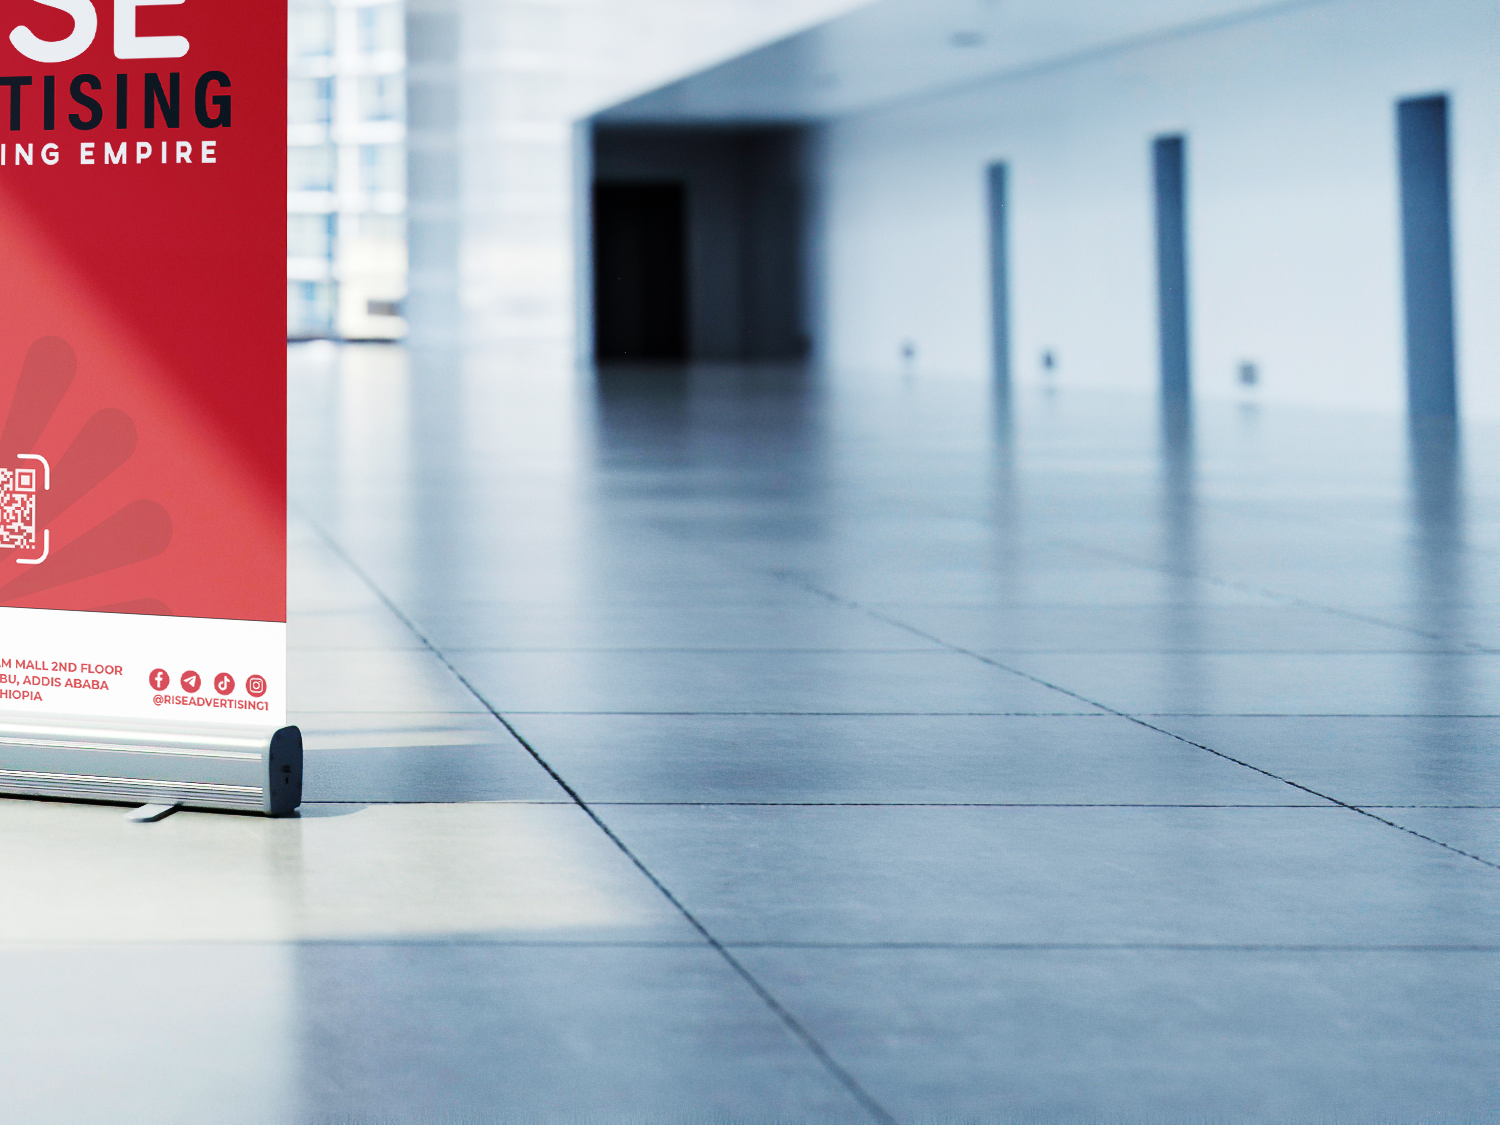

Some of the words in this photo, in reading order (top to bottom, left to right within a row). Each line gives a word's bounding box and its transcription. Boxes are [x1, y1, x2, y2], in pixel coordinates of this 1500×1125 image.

[80, 140, 218, 165] EMPIRE
[15, 659, 49, 671] MALL
[51, 661, 78, 673] 2ND
[80, 663, 123, 676] FLOOR
[22, 675, 62, 687] ADDIS
[64, 678, 109, 691] ABABA
[152, 694, 269, 711] @RISEADVERTISING1
